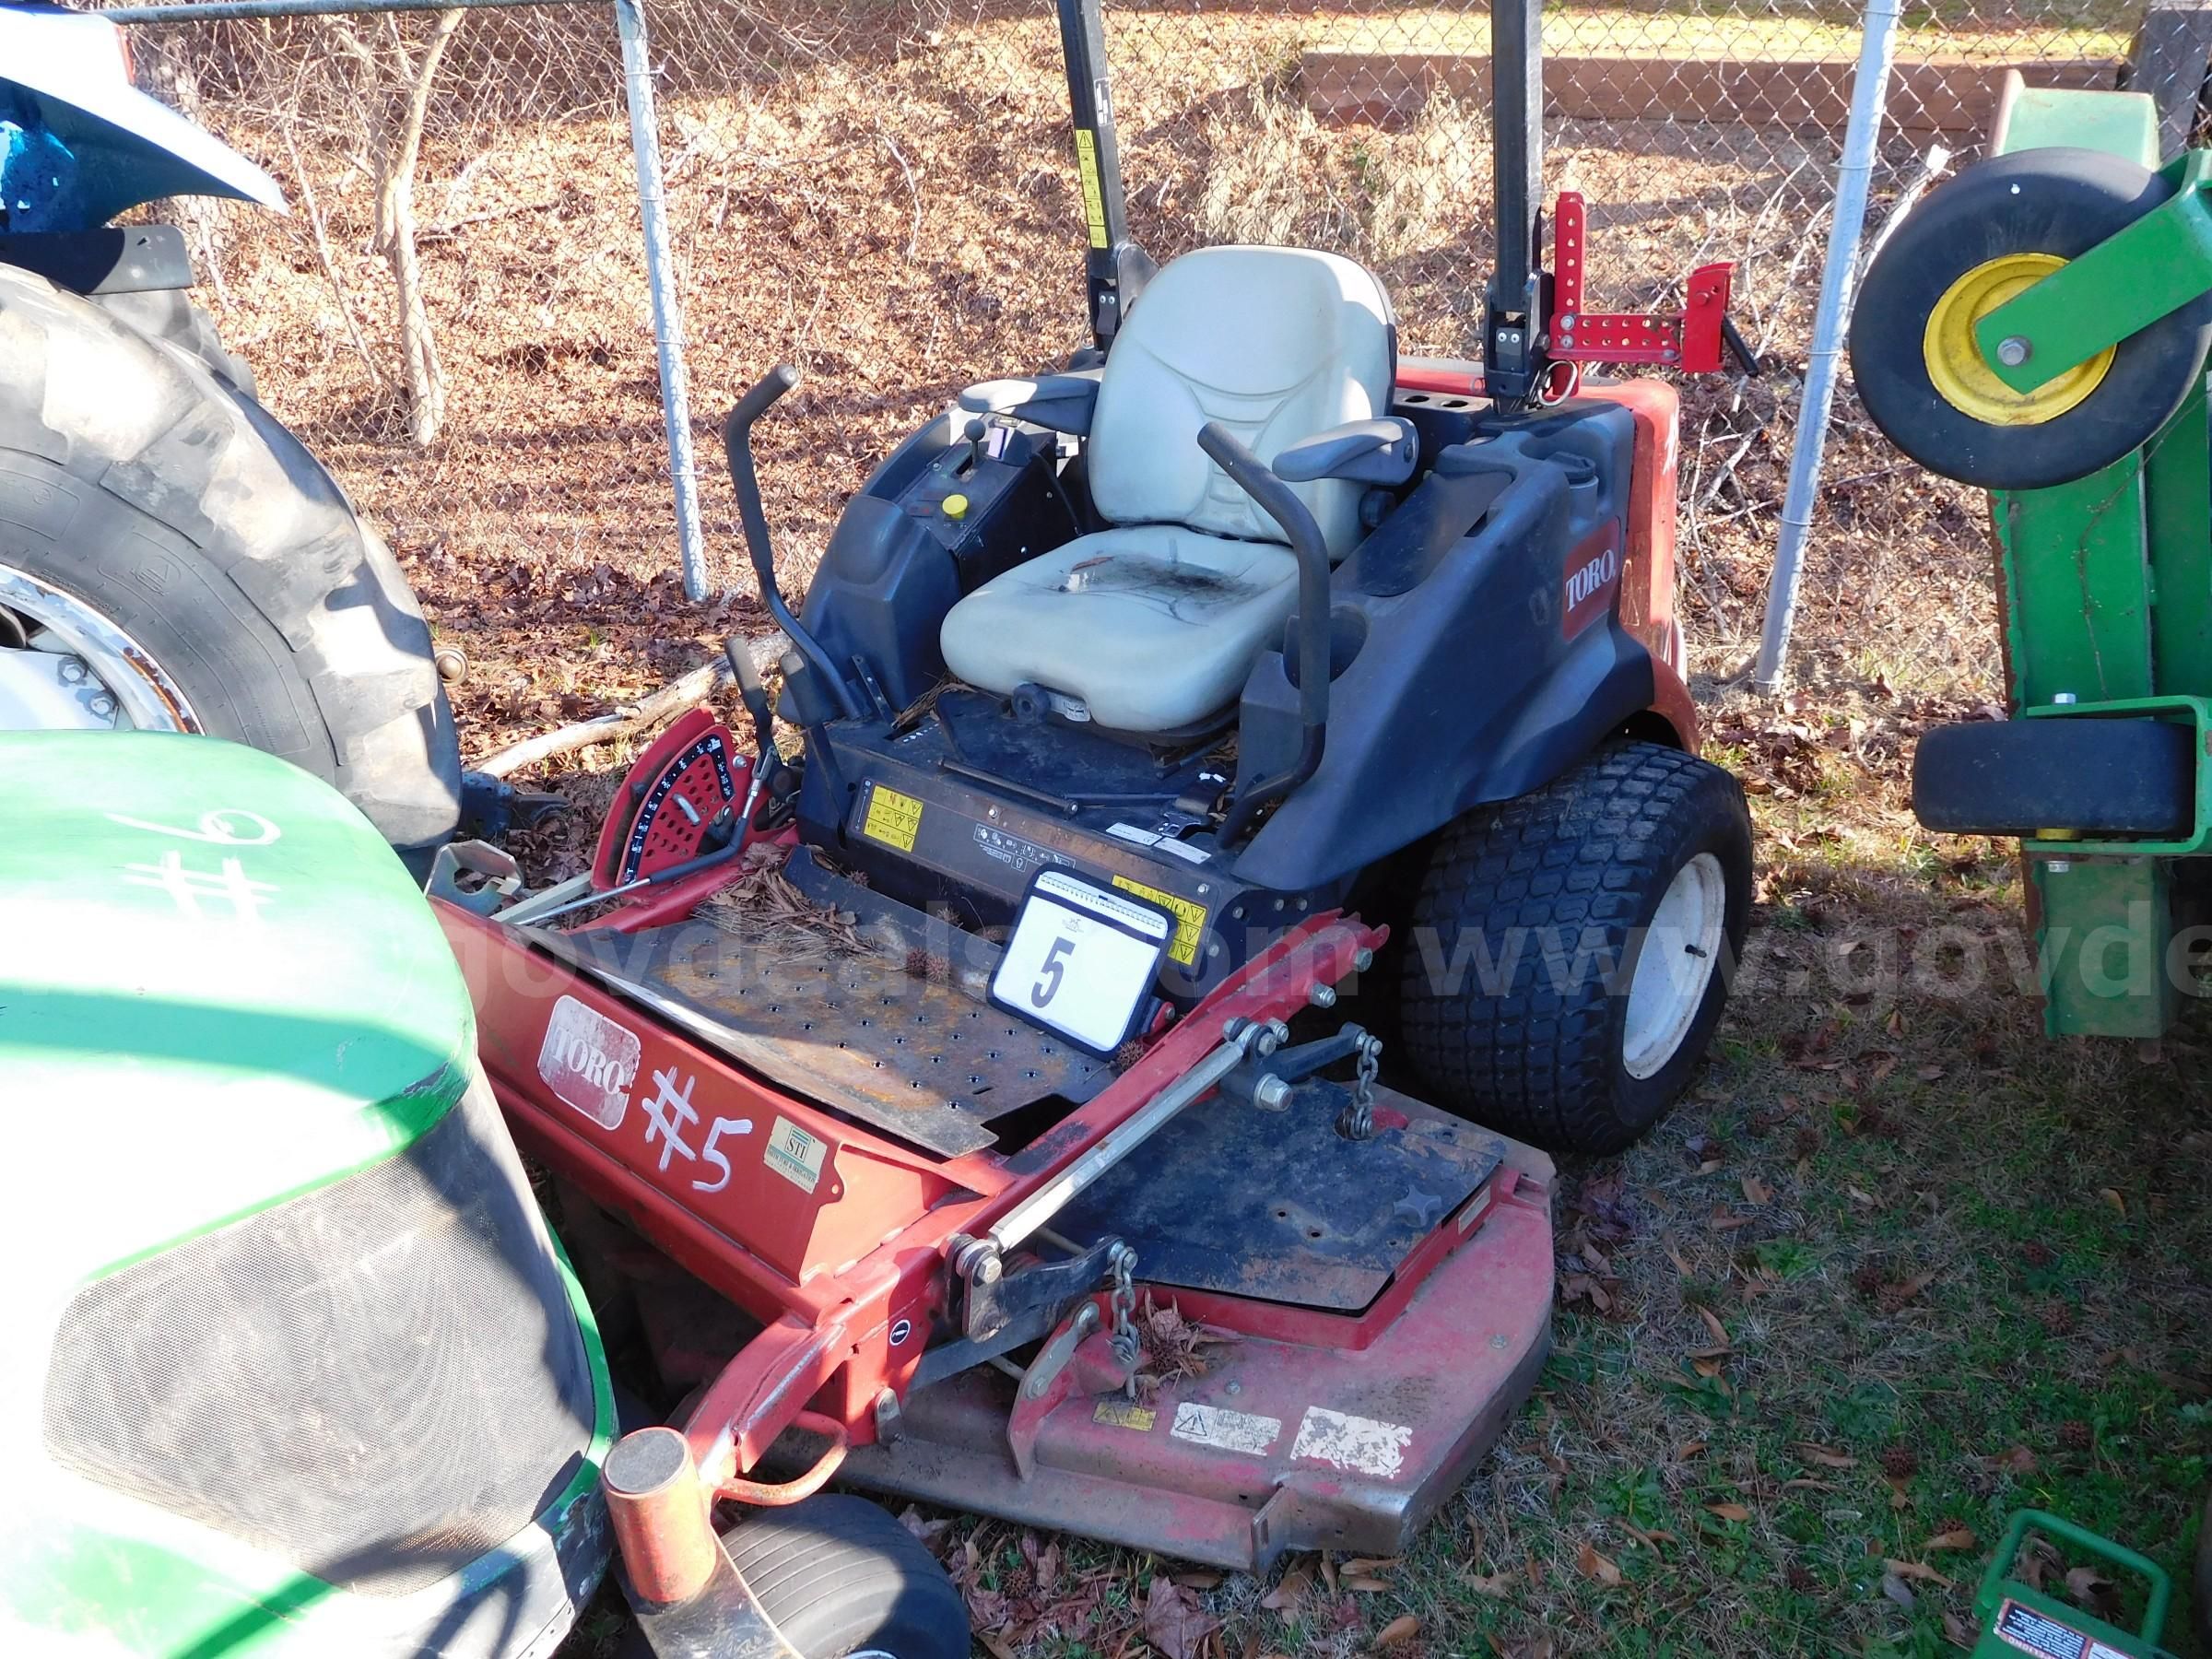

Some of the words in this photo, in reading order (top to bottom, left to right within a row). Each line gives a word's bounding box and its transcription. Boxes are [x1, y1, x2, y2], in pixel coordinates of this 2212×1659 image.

[1565, 548, 1616, 613] TORO
[1030, 936, 1076, 1008] 5
[550, 1026, 625, 1096] TORO
[641, 1066, 753, 1193] #5
[786, 1137, 806, 1159] STI
